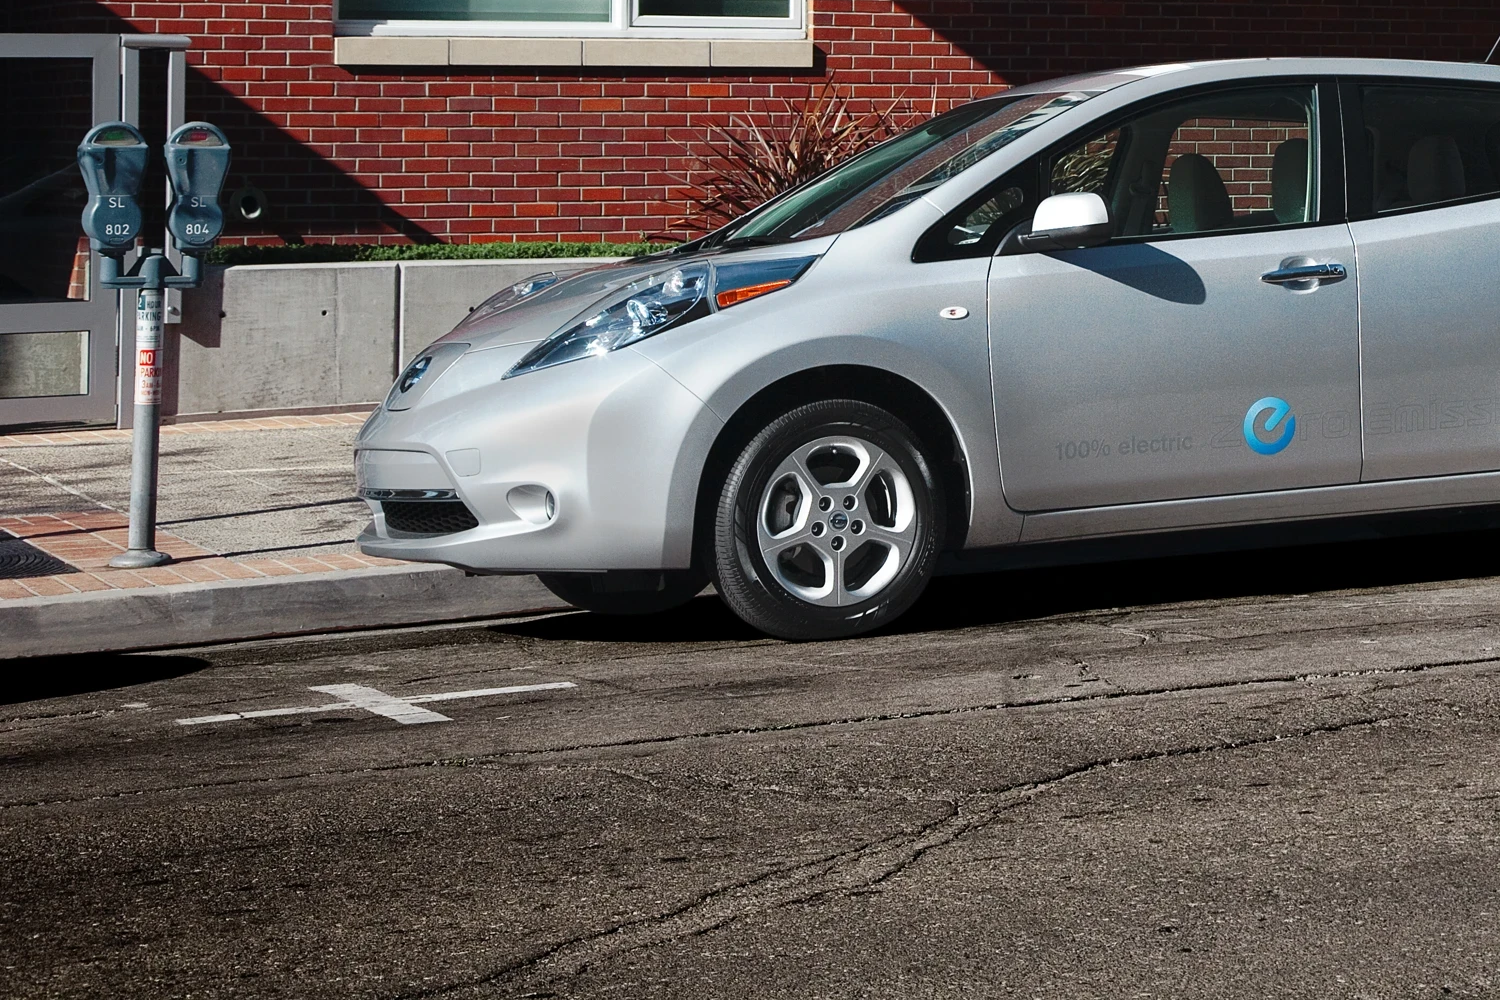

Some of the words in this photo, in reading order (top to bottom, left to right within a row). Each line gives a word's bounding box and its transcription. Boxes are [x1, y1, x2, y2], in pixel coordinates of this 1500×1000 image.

[108, 197, 125, 208] SL
[191, 197, 206, 208] SL
[105, 223, 130, 235] 802
[185, 223, 210, 235] 804
[140, 351, 153, 364] NO
[1055, 440, 1111, 460] 100%
[1118, 433, 1194, 455] electric
